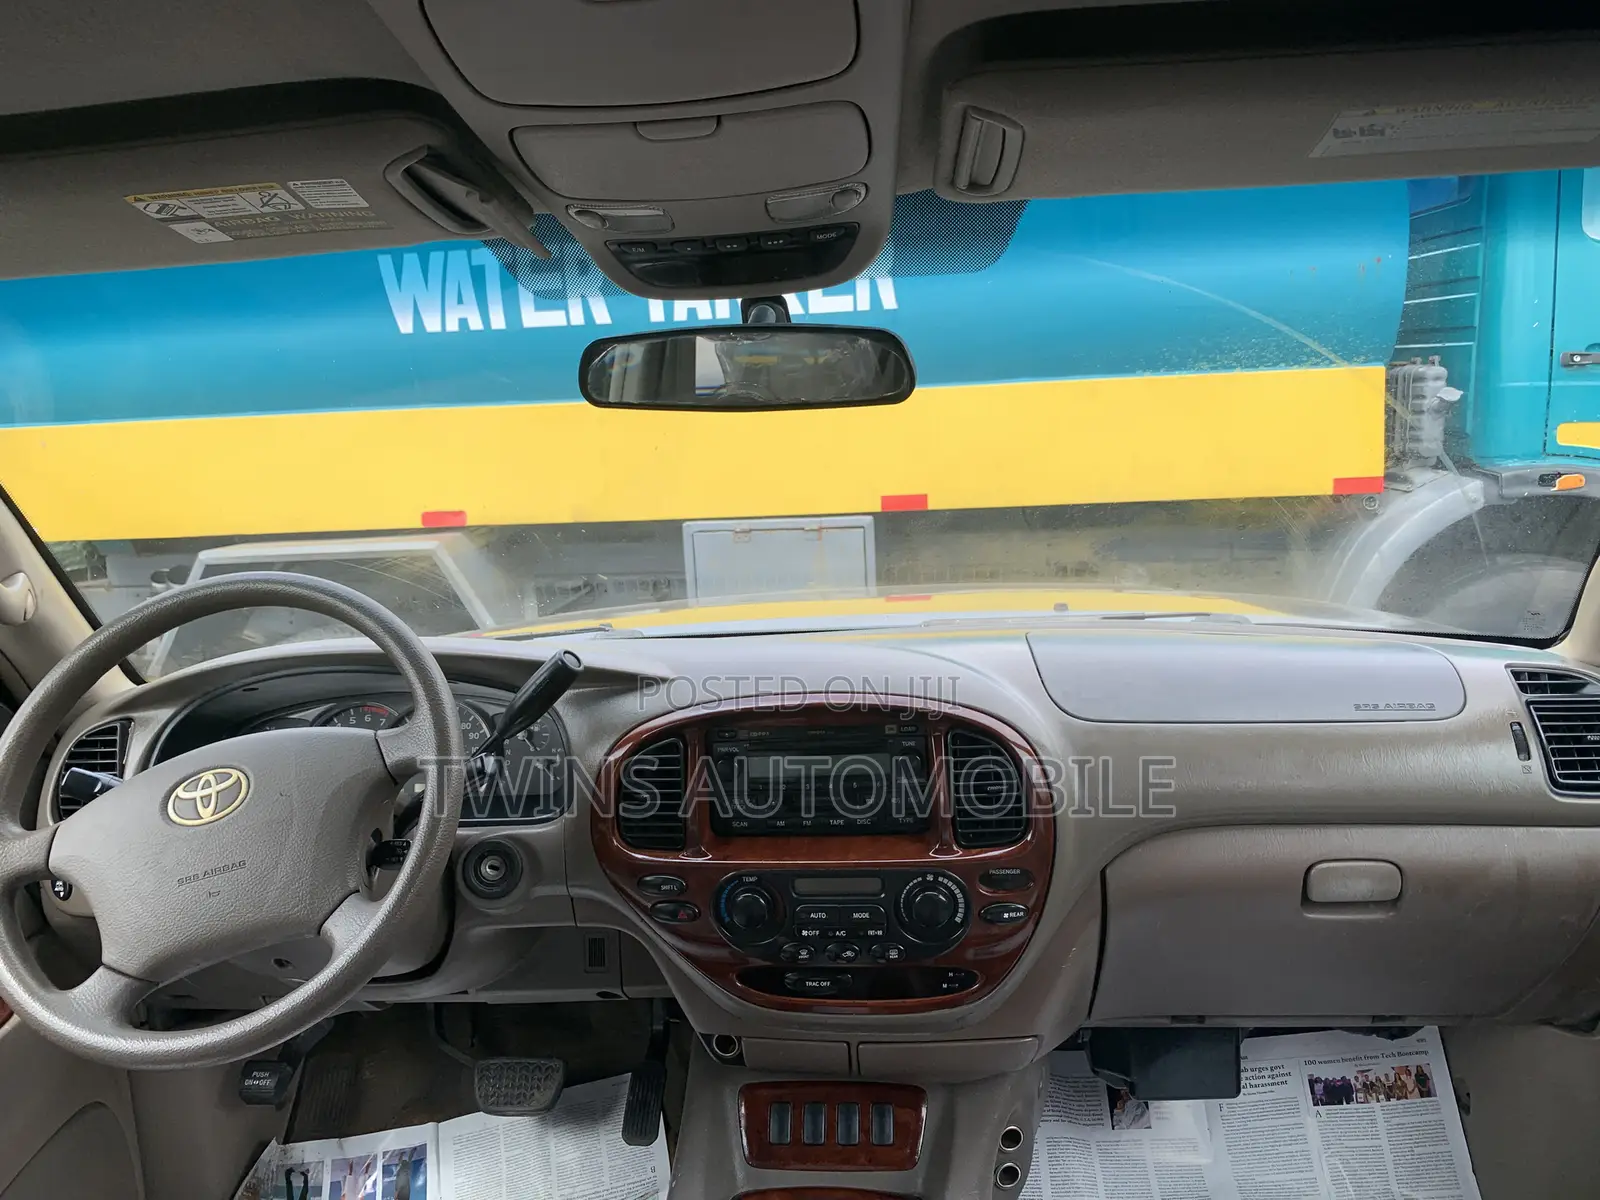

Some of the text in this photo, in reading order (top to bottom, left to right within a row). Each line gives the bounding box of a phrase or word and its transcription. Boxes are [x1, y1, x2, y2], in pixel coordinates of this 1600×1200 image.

[289, 209, 376, 221] WARNING
[816, 232, 838, 240] MODE
[377, 248, 613, 334] WATER
[349, 714, 386, 726] 5 6 7
[460, 722, 472, 730] 80
[468, 732, 480, 740] 90
[202, 859, 247, 878] AIRBAG
[1317, 1057, 1341, 1065] women
[1341, 1054, 1364, 1063] benefit
[1364, 1053, 1380, 1062] from
[1380, 1051, 1397, 1060] Tech
[1397, 1048, 1430, 1058] Bootcamp
[251, 1070, 271, 1078] PUSH
[1249, 1066, 1269, 1074] urges
[1269, 1064, 1285, 1073] govt
[1244, 1070, 1292, 1082] action against
[258, 1078, 272, 1086] OFF
[1248, 1079, 1288, 1089] harassment
